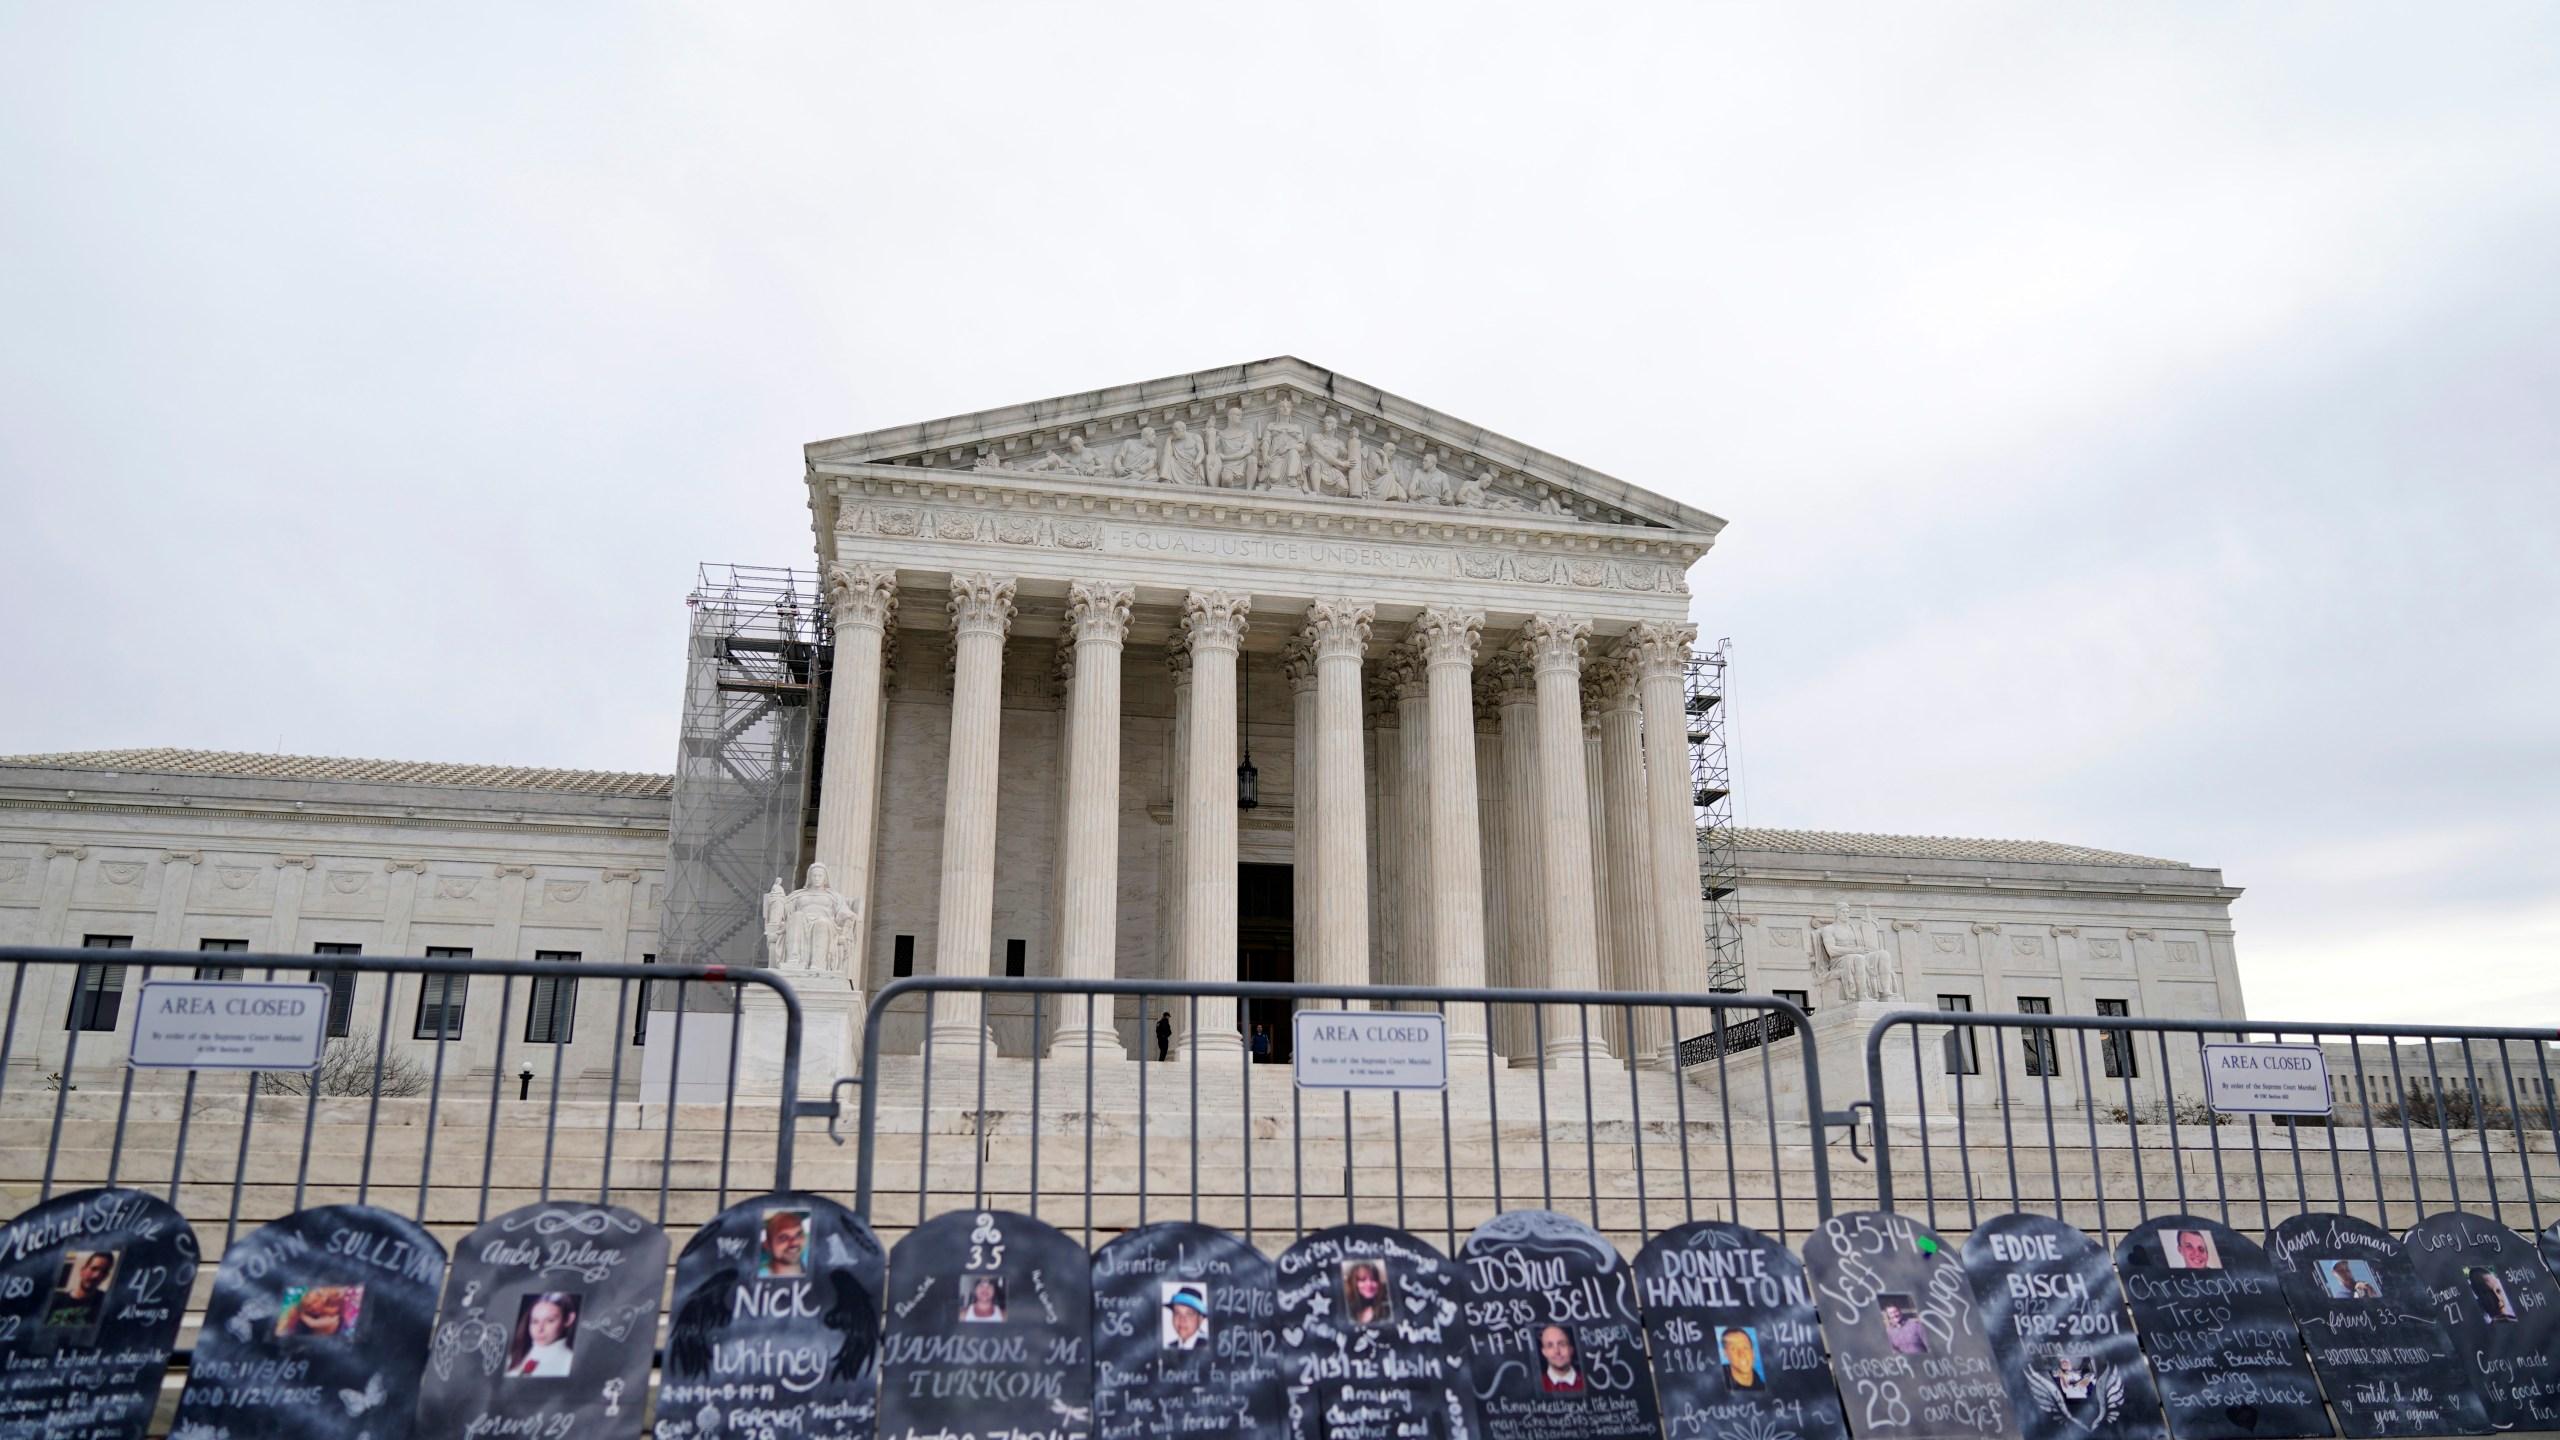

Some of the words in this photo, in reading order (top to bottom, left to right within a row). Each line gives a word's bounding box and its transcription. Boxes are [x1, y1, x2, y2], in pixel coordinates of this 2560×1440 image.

[1120, 531, 1201, 554] EQUAL
[1203, 539, 1298, 561] JUSTICE
[1310, 543, 1386, 566] UNDER
[1395, 550, 1440, 570] LAW
[160, 997, 215, 1014] AREA
[225, 998, 305, 1016] CLOSED
[1314, 1026, 1359, 1041] AREA
[1366, 1026, 1429, 1042] CLOSED
[2221, 1056, 2258, 1069] AREA
[2263, 1056, 2312, 1070] CLOSED
[0, 1203, 84, 1260] Michael
[1826, 1216, 1918, 1256] 8-5-14
[2418, 1228, 2461, 1252] Corey
[2461, 1222, 2502, 1252] Long
[232, 1230, 309, 1290] JOHN
[326, 1227, 444, 1288] SULLIVAN
[1179, 1243, 1232, 1278] Lyon
[1989, 1233, 2063, 1263] EDDIE
[2275, 1229, 2320, 1272] Jason
[129, 1266, 168, 1304] 42
[1646, 1275, 1806, 1308] HAMILTON
[2006, 1272, 2090, 1300] BISCH
[2129, 1270, 2268, 1305] Christopher
[118, 1304, 169, 1327] Always
[2014, 1298, 2049, 1316] 9/22
[2157, 1302, 2231, 1332] Trejo
[2327, 1311, 2376, 1335] forever
[2378, 1309, 2397, 1325] 33
[2444, 1302, 2464, 1325] 27
[1101, 1312, 1134, 1337] 36
[884, 1331, 1027, 1367] JAMISON
[1044, 1337, 1085, 1365] M.
[2019, 1337, 2065, 1356] loving
[2067, 1341, 2094, 1354] son
[2224, 1350, 2292, 1367] Beautiful
[1586, 1344, 1634, 1390] 33
[1954, 1356, 1991, 1377] SON
[2477, 1350, 2514, 1383] Corey
[2517, 1349, 2548, 1367] made
[908, 1368, 1066, 1402] TURKOW
[2203, 1371, 2256, 1393] Loving
[2262, 1385, 2312, 1405] Uncle
[2411, 1387, 2433, 1402] see
[2484, 1381, 2507, 1402] life
[2512, 1377, 2541, 1410] good
[1097, 1389, 1116, 1417] I
[1124, 1390, 1154, 1413] love
[1159, 1397, 1184, 1419] you
[1683, 1401, 1764, 1433] forever
[1774, 1399, 1803, 1428] 24
[1858, 1379, 1911, 1430] 28
[2529, 1399, 2557, 1420] fun
[546, 1412, 575, 1435] 29
[1101, 1416, 1144, 1439] heart
[1150, 1412, 1174, 1433] will
[1183, 1411, 1232, 1432] forever
[1239, 1410, 1258, 1430] be
[2374, 1409, 2399, 1434] you
